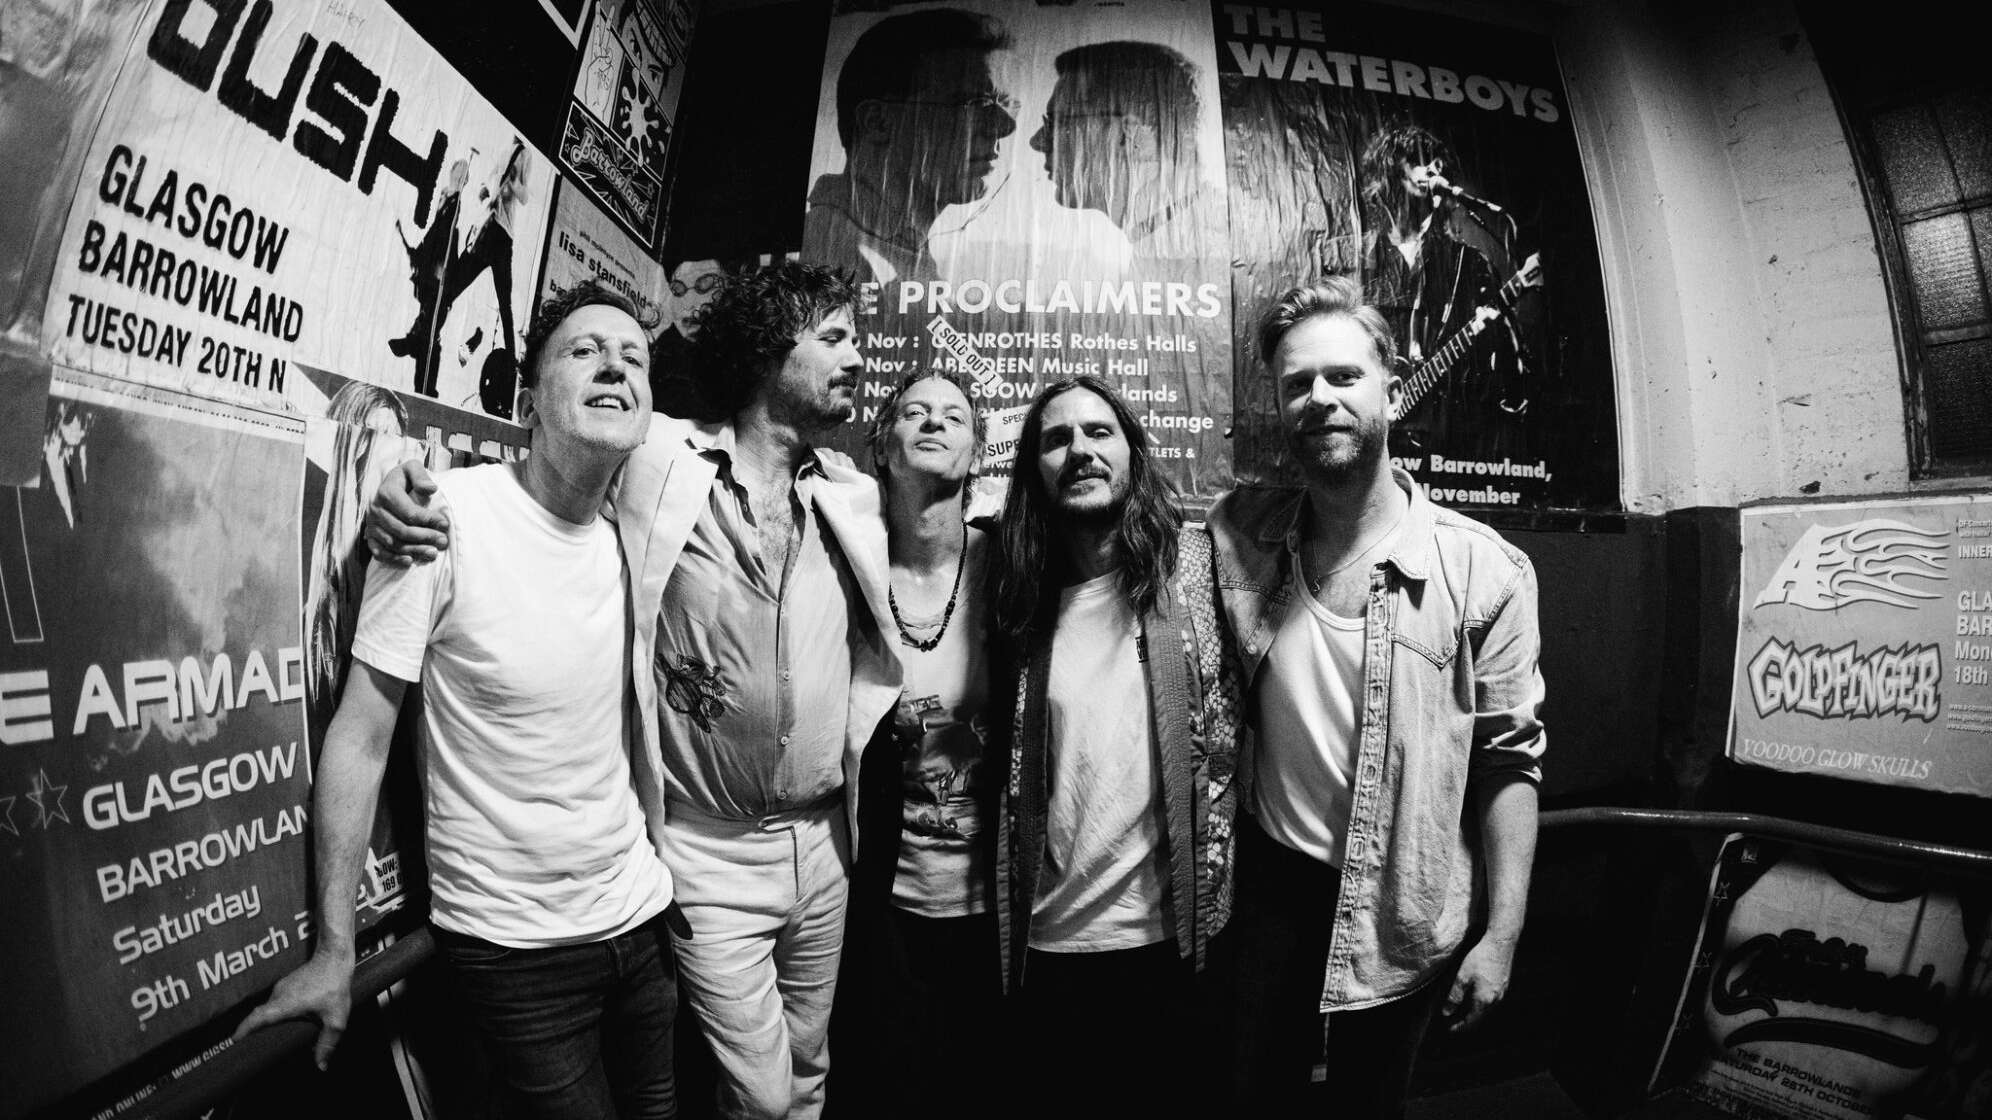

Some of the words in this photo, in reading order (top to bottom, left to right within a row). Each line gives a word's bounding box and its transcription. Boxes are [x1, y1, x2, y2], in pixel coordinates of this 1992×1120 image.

[1224, 4, 1326, 42] THE
[1227, 41, 1559, 123] WATERBOYS
[570, 127, 651, 225] Barrowland
[100, 144, 289, 274] GLASGOW
[559, 231, 586, 263] lisa
[78, 219, 303, 343] BARROWLAND
[898, 279, 1222, 318] PROCLAIMERS
[66, 294, 191, 368] TUESDAY
[198, 336, 261, 388] 20TH
[931, 332, 1063, 350] GNROTHES
[1071, 333, 1138, 350] Rothes
[1147, 334, 1197, 352] Halls
[939, 327, 967, 355] SOLD
[965, 353, 990, 375] OUT
[931, 357, 1034, 374] ABEDEEN
[1042, 358, 1100, 374] Music
[1107, 358, 1149, 376] Hall
[1430, 454, 1552, 482] Barrowland,
[1954, 640, 1992, 660] Mon
[1748, 636, 1942, 723] GOLDFINGER
[1953, 664, 1988, 685] 18th
[1743, 738, 1815, 764] VOODOO
[1817, 748, 1869, 771] GLOW
[1866, 754, 1933, 780] SKULLS
[83, 742, 297, 830] GLASGOW
[112, 885, 261, 965] Saturday
[130, 976, 190, 1023] 9th
[196, 925, 289, 990] March
[1736, 1047, 1761, 1066] THE
